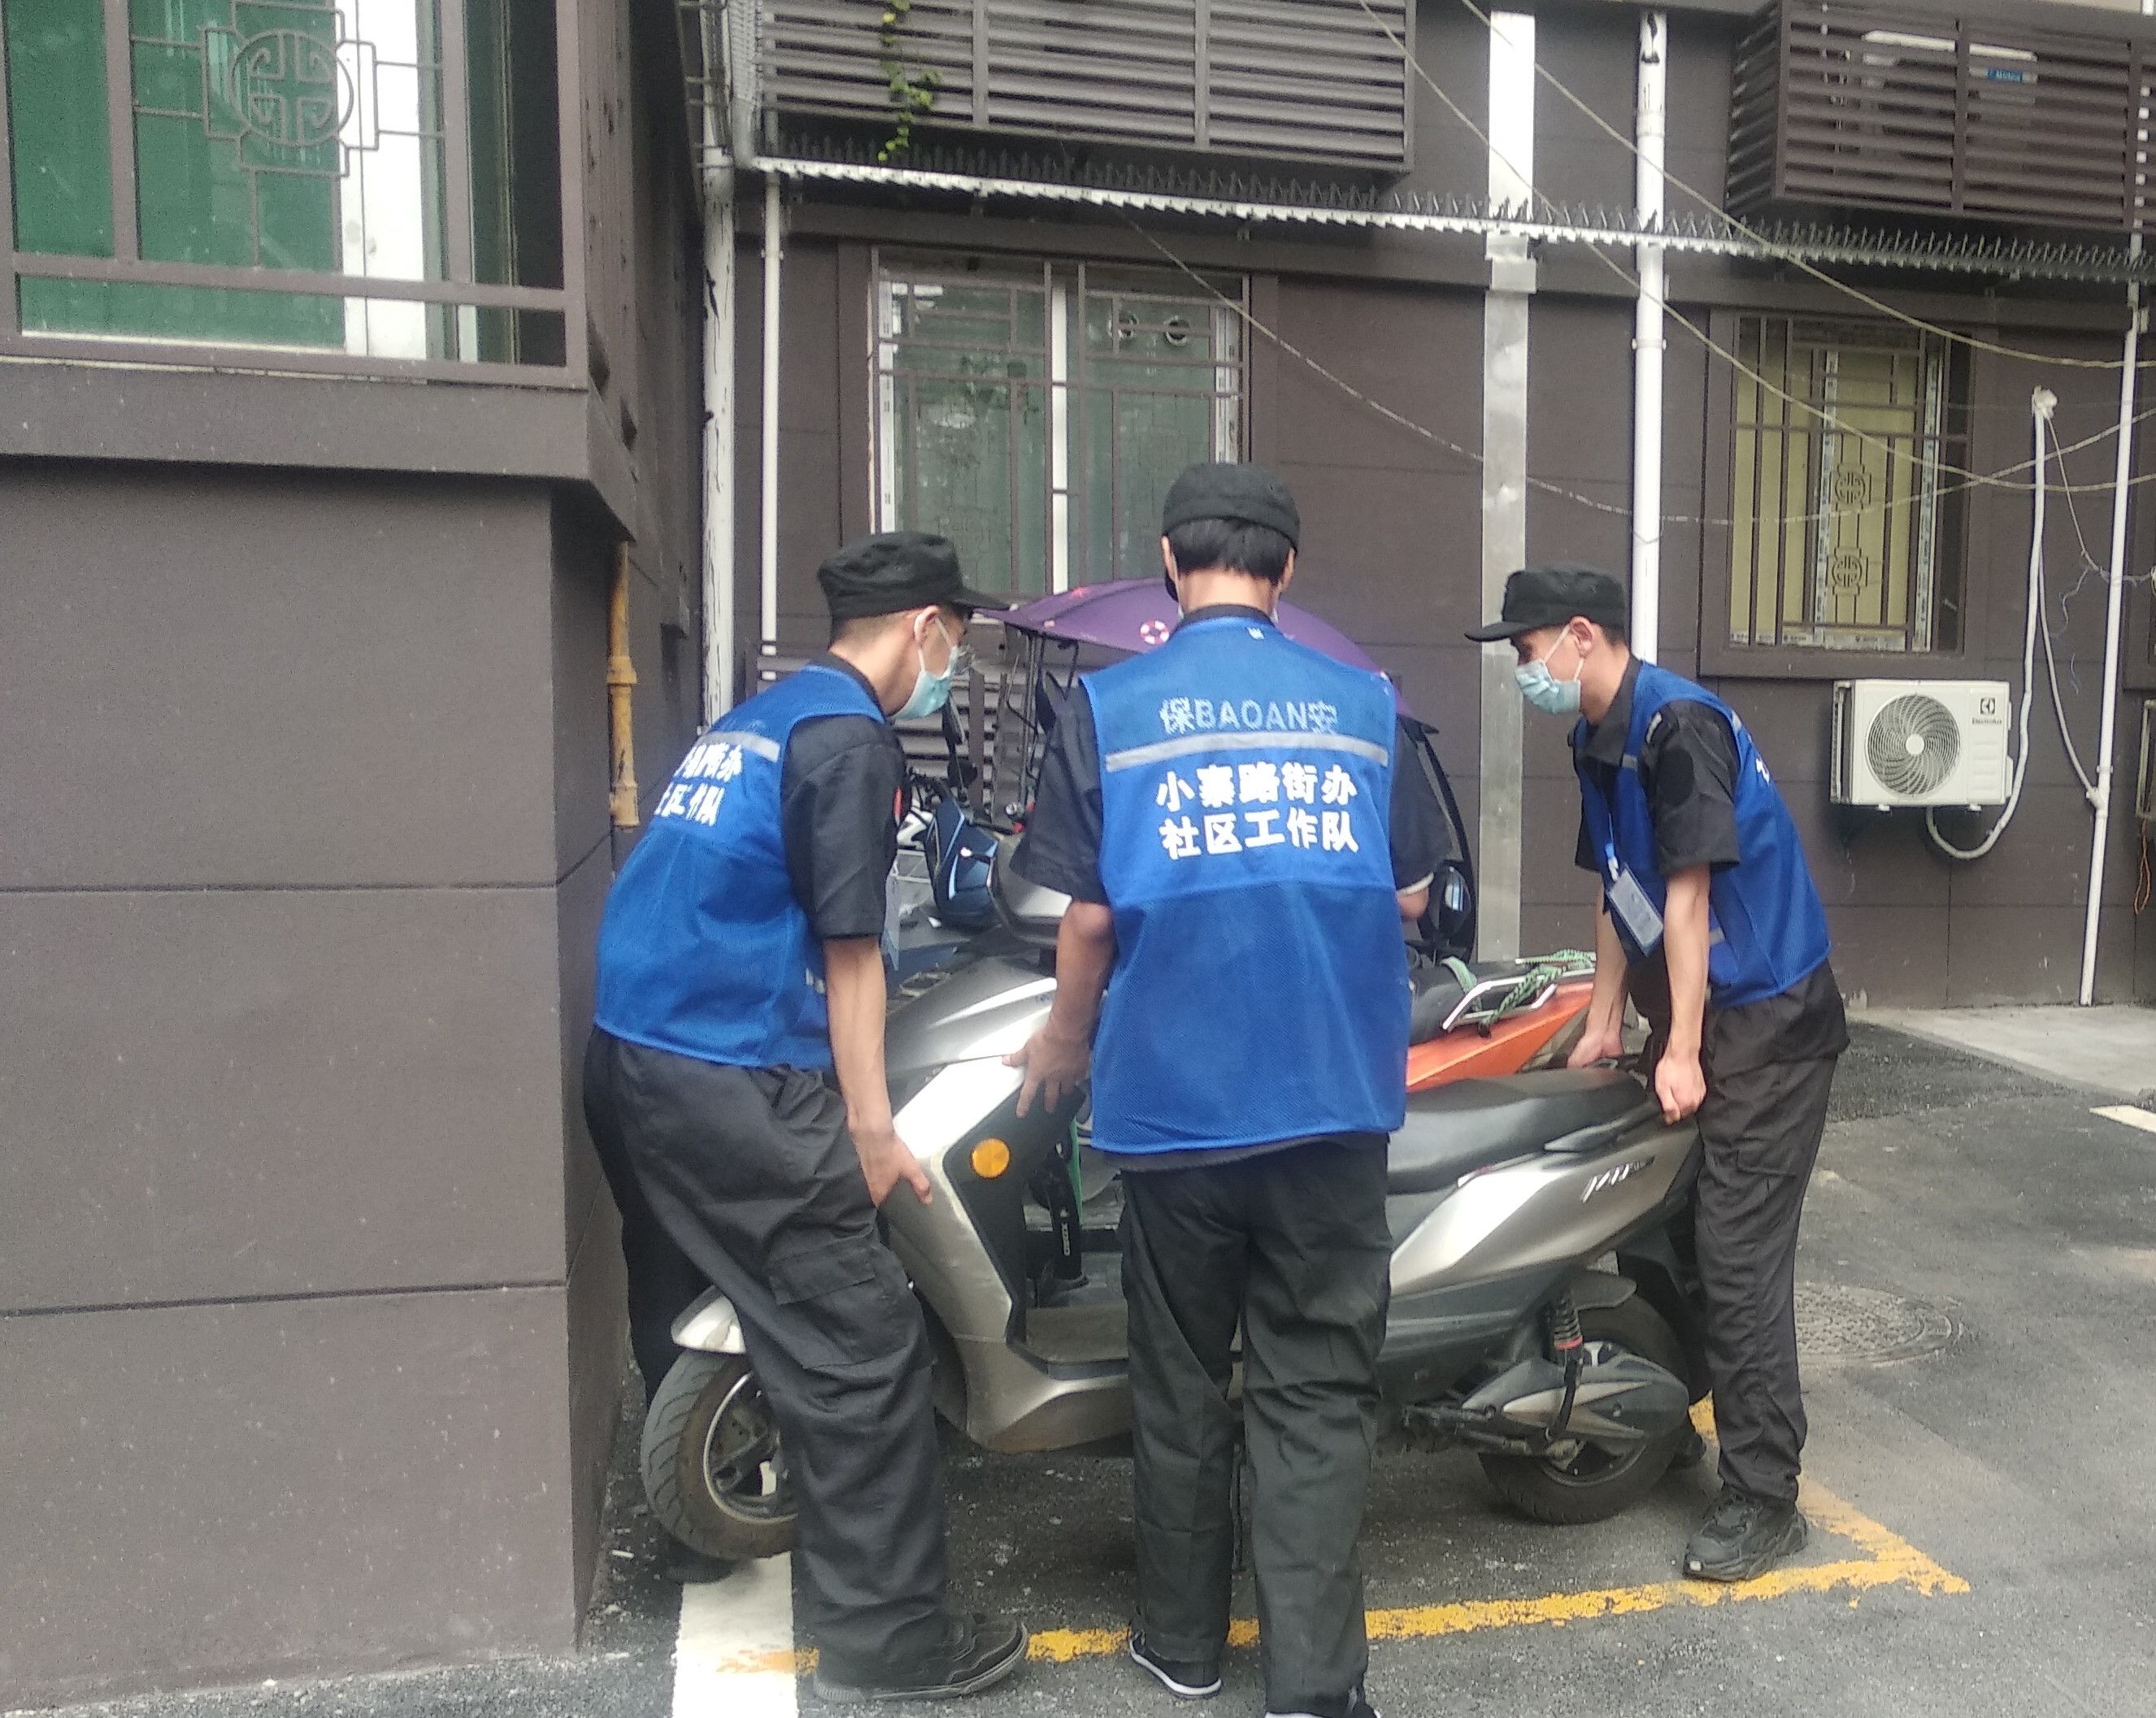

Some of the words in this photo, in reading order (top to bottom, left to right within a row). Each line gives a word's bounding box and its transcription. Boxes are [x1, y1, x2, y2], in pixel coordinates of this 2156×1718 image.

[1155, 761, 1358, 812] 小寨路街办
[1158, 807, 1359, 860] 社区工作队
